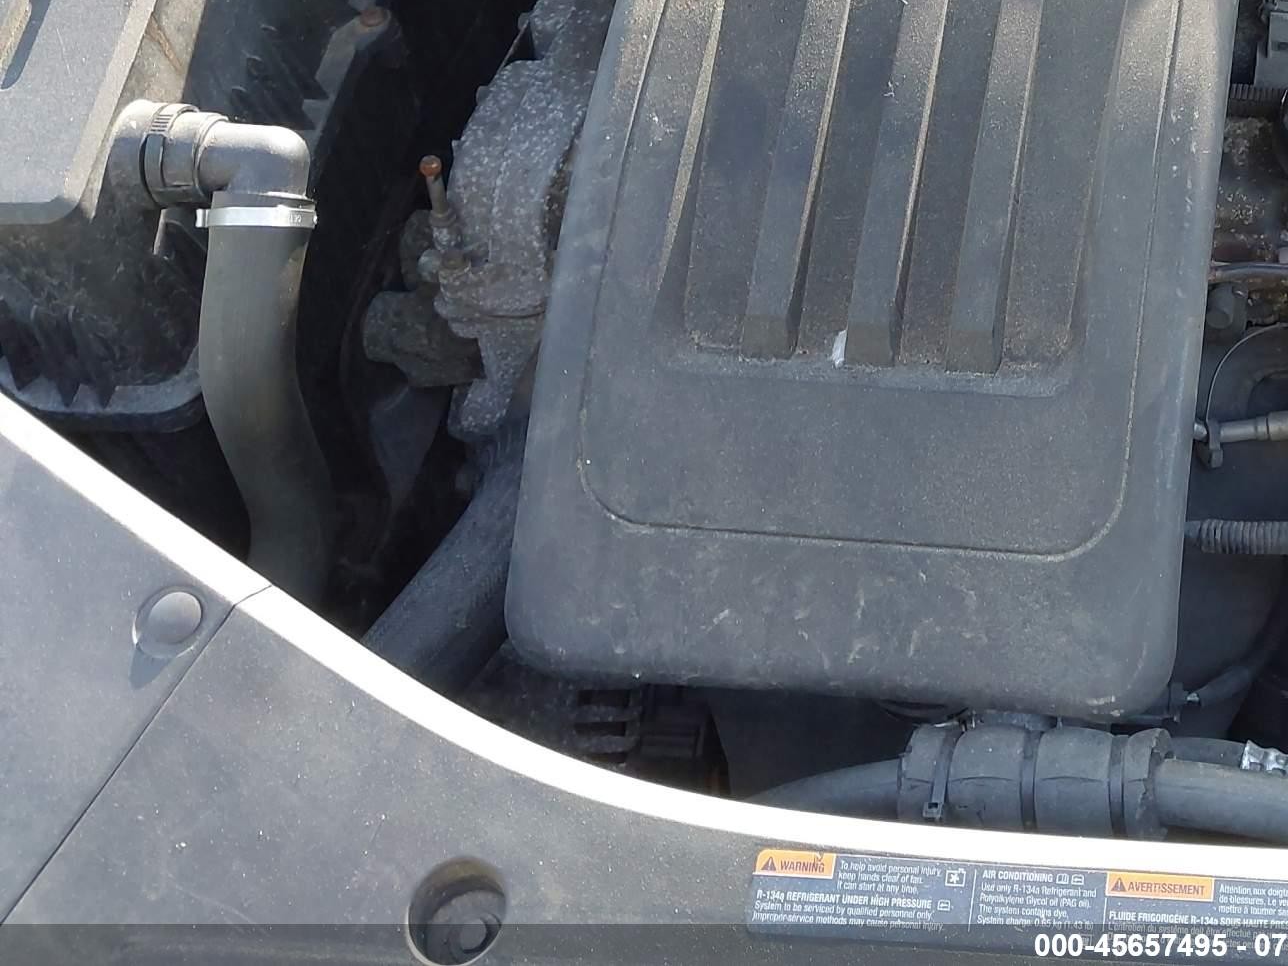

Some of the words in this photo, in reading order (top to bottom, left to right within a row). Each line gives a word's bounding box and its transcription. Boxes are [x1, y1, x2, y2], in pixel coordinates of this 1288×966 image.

[780, 859, 825, 873] WARNING
[981, 869, 997, 880] AIR
[998, 871, 1054, 883] CONDITIONING
[1127, 881, 1206, 896] AVERTISSEMENT
[754, 900, 782, 912] System
[786, 891, 841, 904] REFRIGERANT
[842, 894, 869, 906] UNDER
[870, 895, 890, 907] HIGH
[891, 897, 933, 909] PRESSURE
[1109, 910, 1136, 922] FLUIDE
